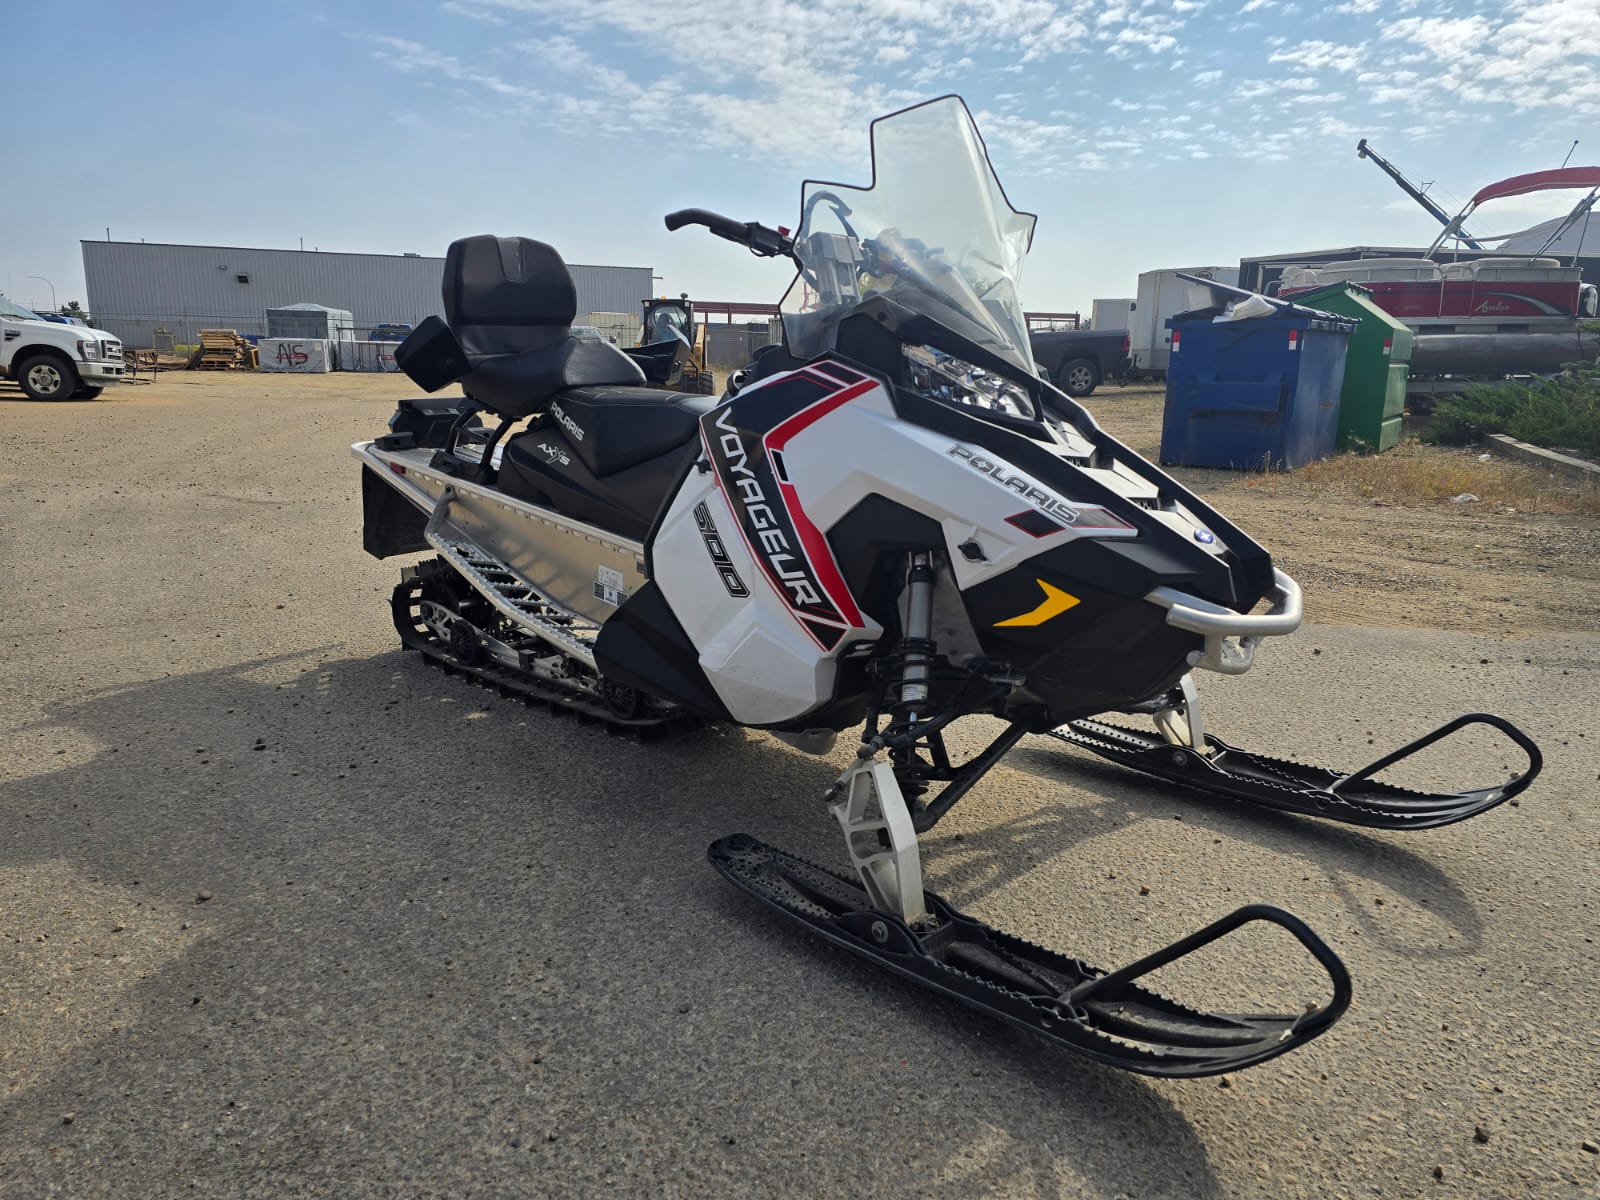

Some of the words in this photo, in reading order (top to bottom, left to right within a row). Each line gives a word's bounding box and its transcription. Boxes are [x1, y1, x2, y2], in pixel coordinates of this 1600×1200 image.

[551, 401, 584, 441] POLARIS
[715, 407, 822, 606] VOYAGEUR
[948, 444, 1080, 523] POLARIS
[693, 501, 750, 598] 500
